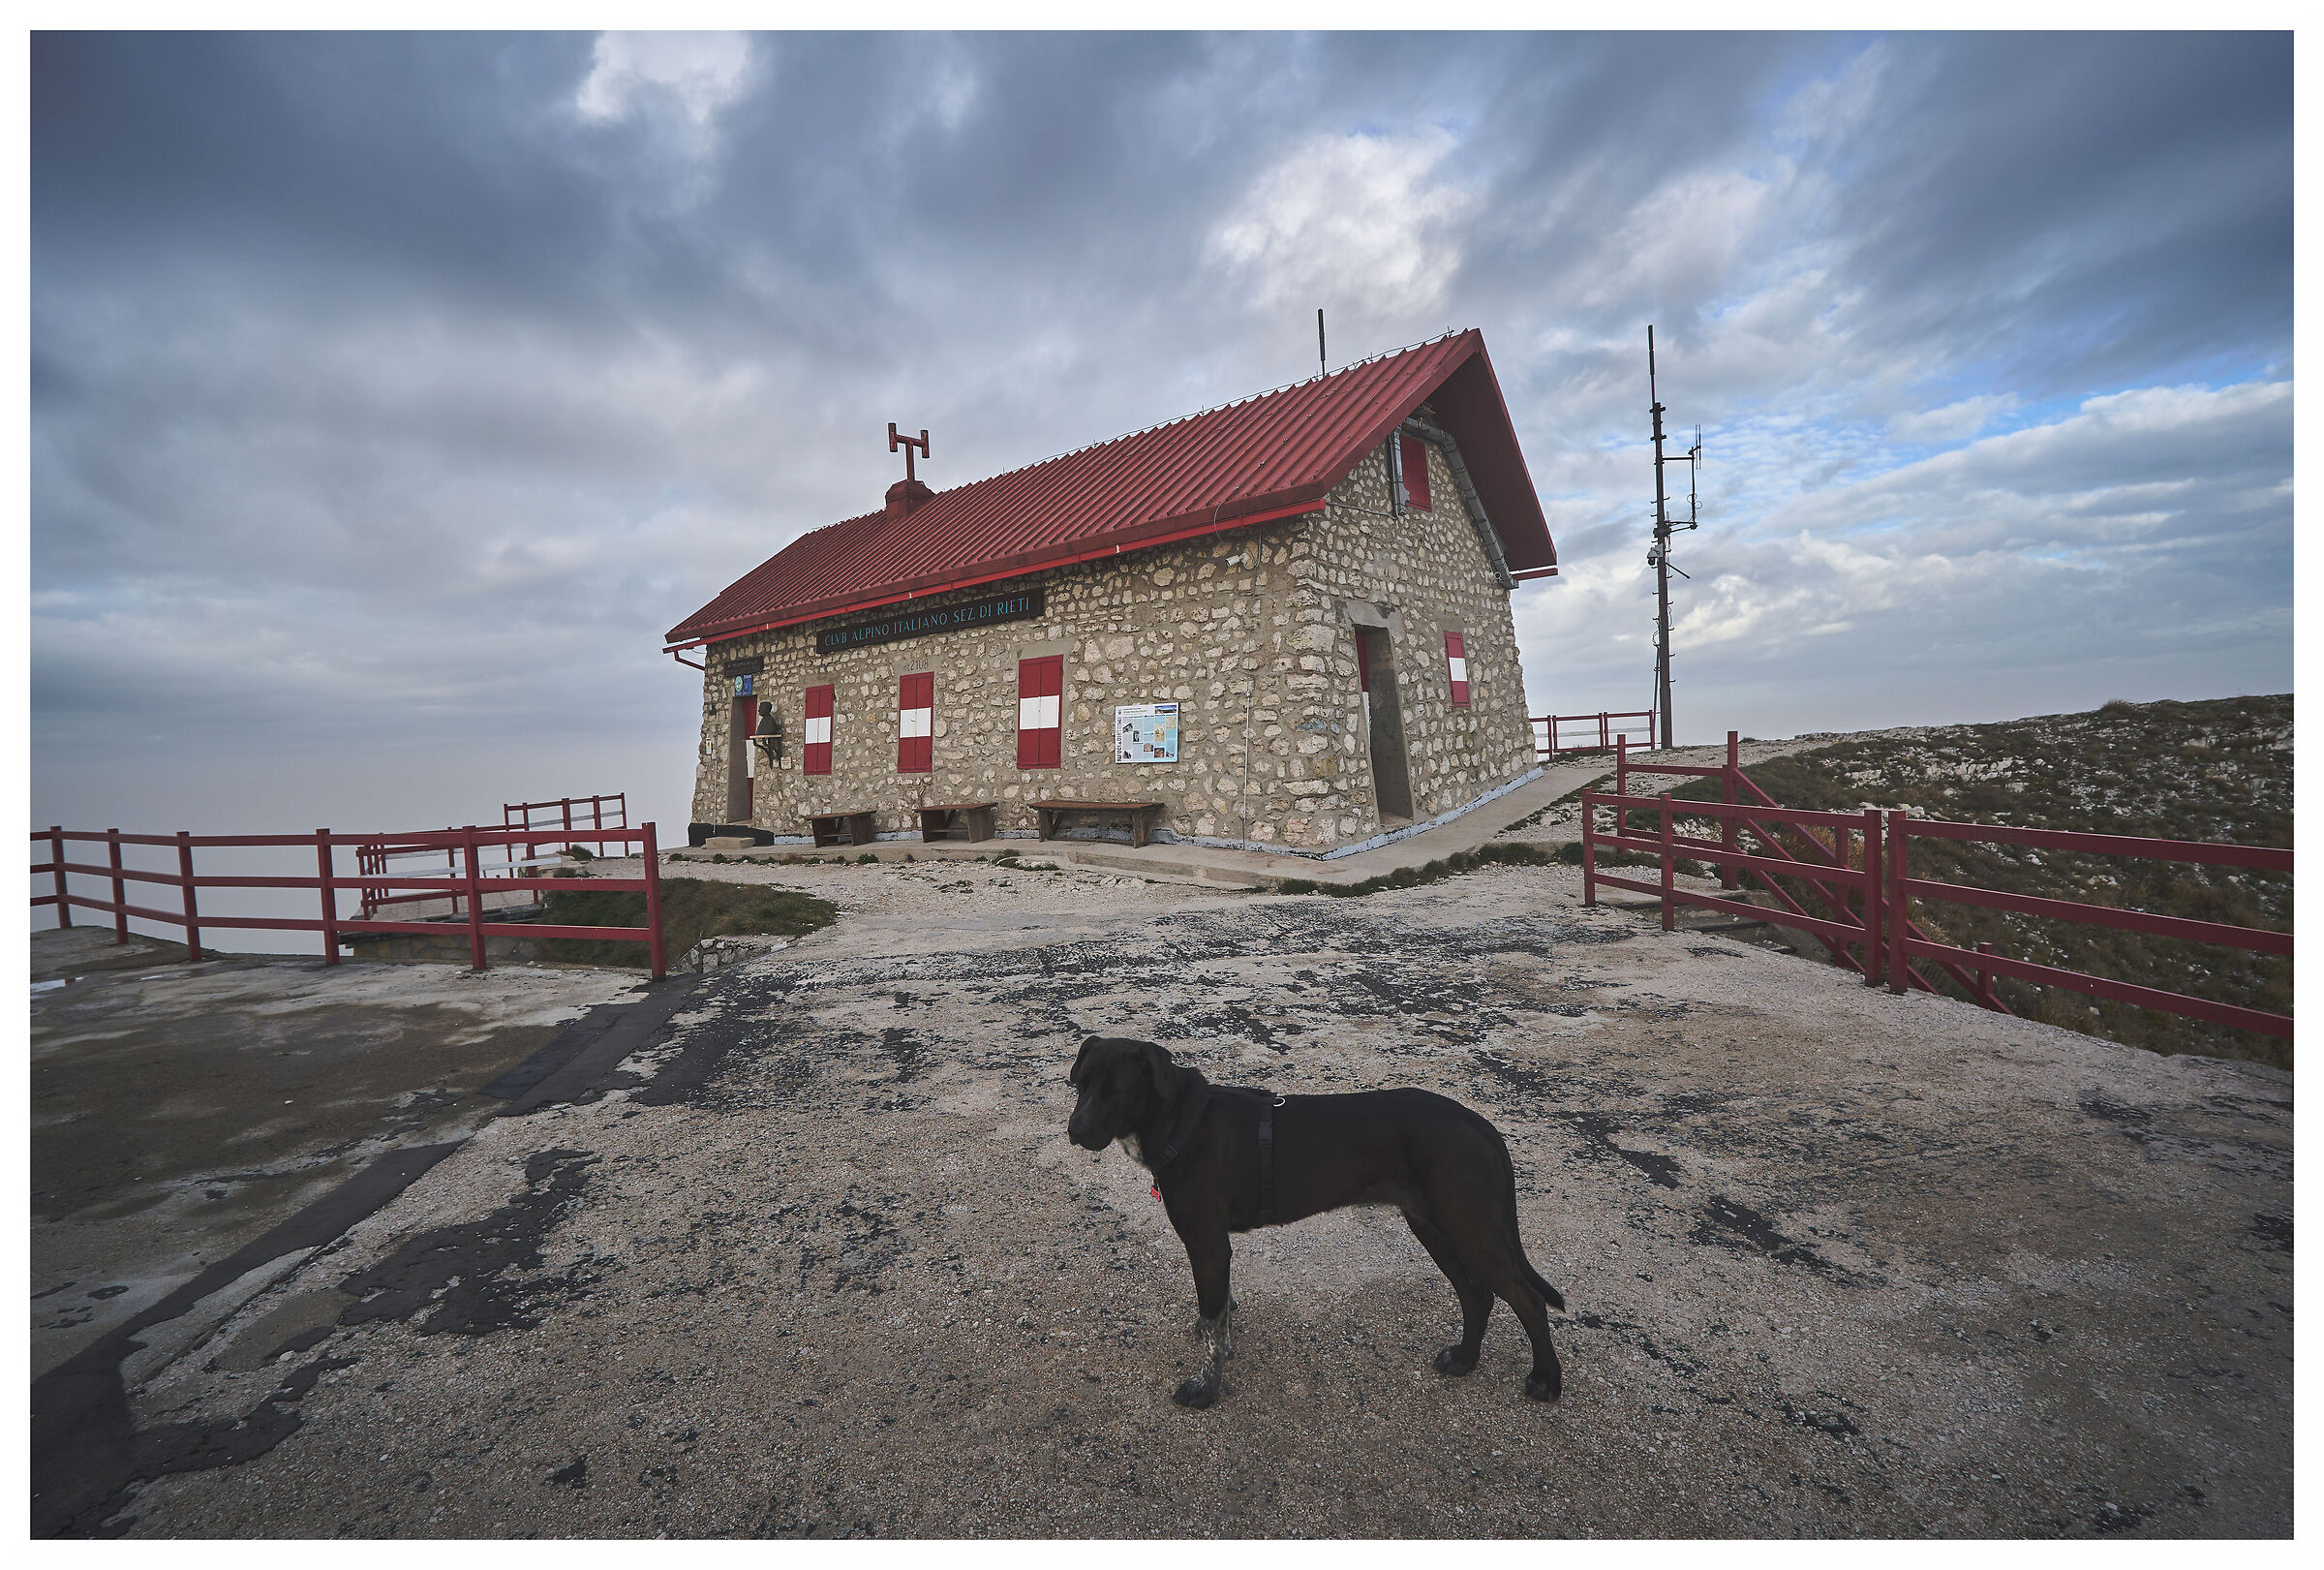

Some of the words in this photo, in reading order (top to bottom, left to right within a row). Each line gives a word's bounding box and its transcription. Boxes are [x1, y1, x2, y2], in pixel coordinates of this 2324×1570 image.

[824, 631, 847, 647] CLVB
[851, 624, 890, 641] ALPINO
[893, 612, 948, 634] ITALIANO
[953, 606, 976, 623] SEZ.
[979, 602, 992, 619] DI
[996, 597, 1029, 615] RIETI
